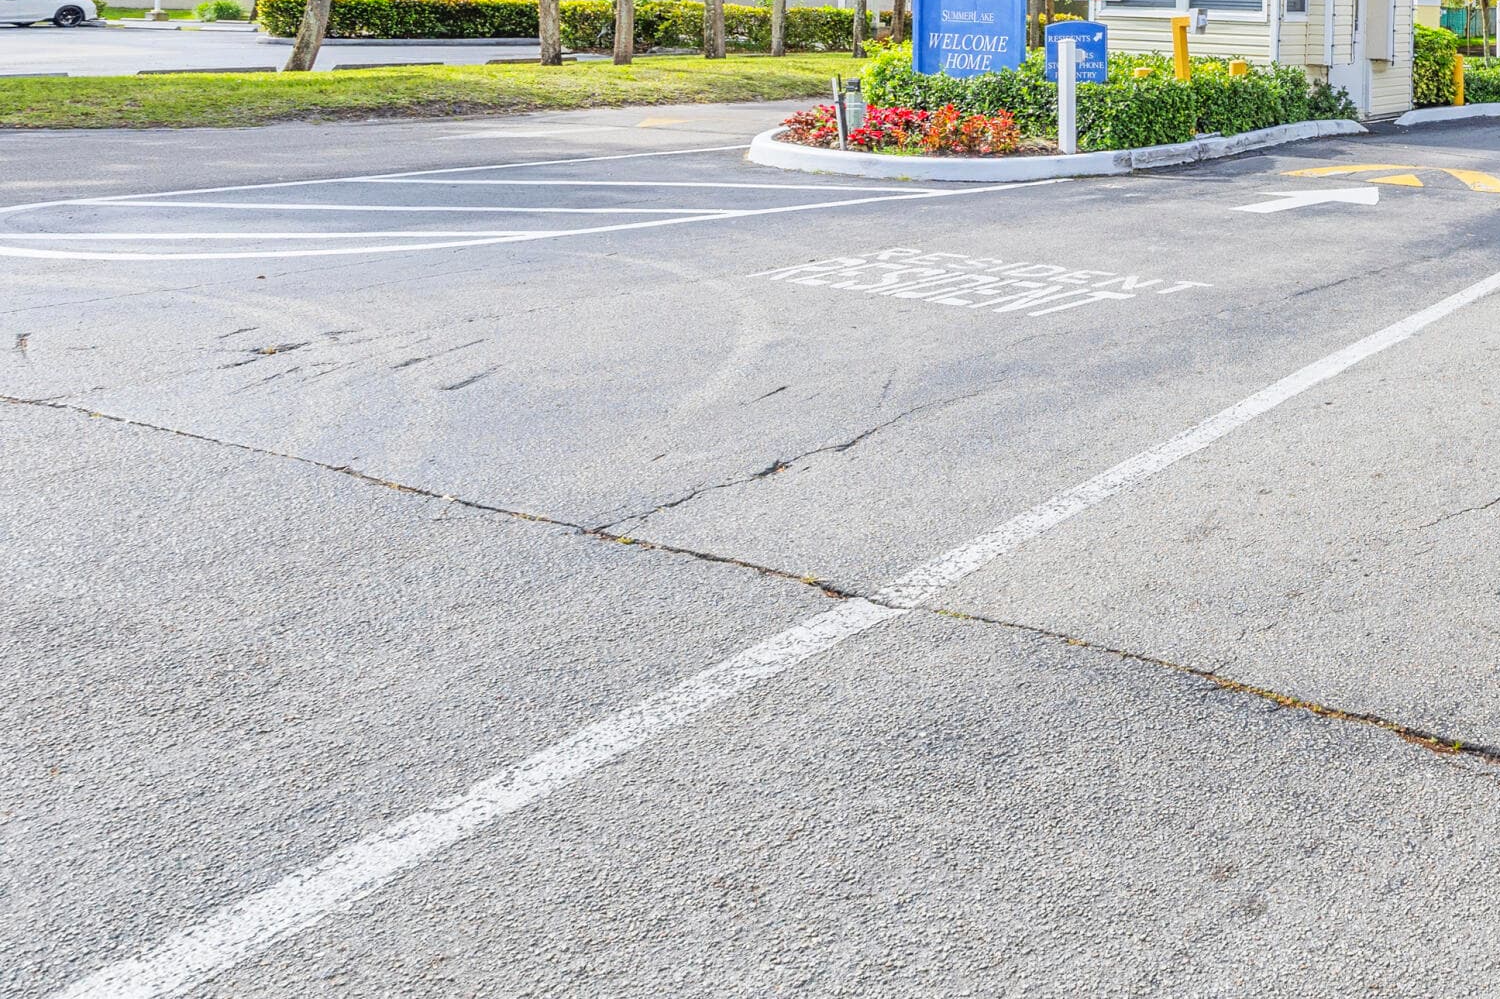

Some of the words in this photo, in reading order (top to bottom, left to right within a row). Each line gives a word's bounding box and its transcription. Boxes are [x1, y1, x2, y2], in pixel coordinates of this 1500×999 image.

[928, 32, 1009, 52] WELCOME
[944, 52, 993, 71] HOME
[1075, 71, 1097, 79] NTRY
[745, 256, 1137, 317] RESIDENT
